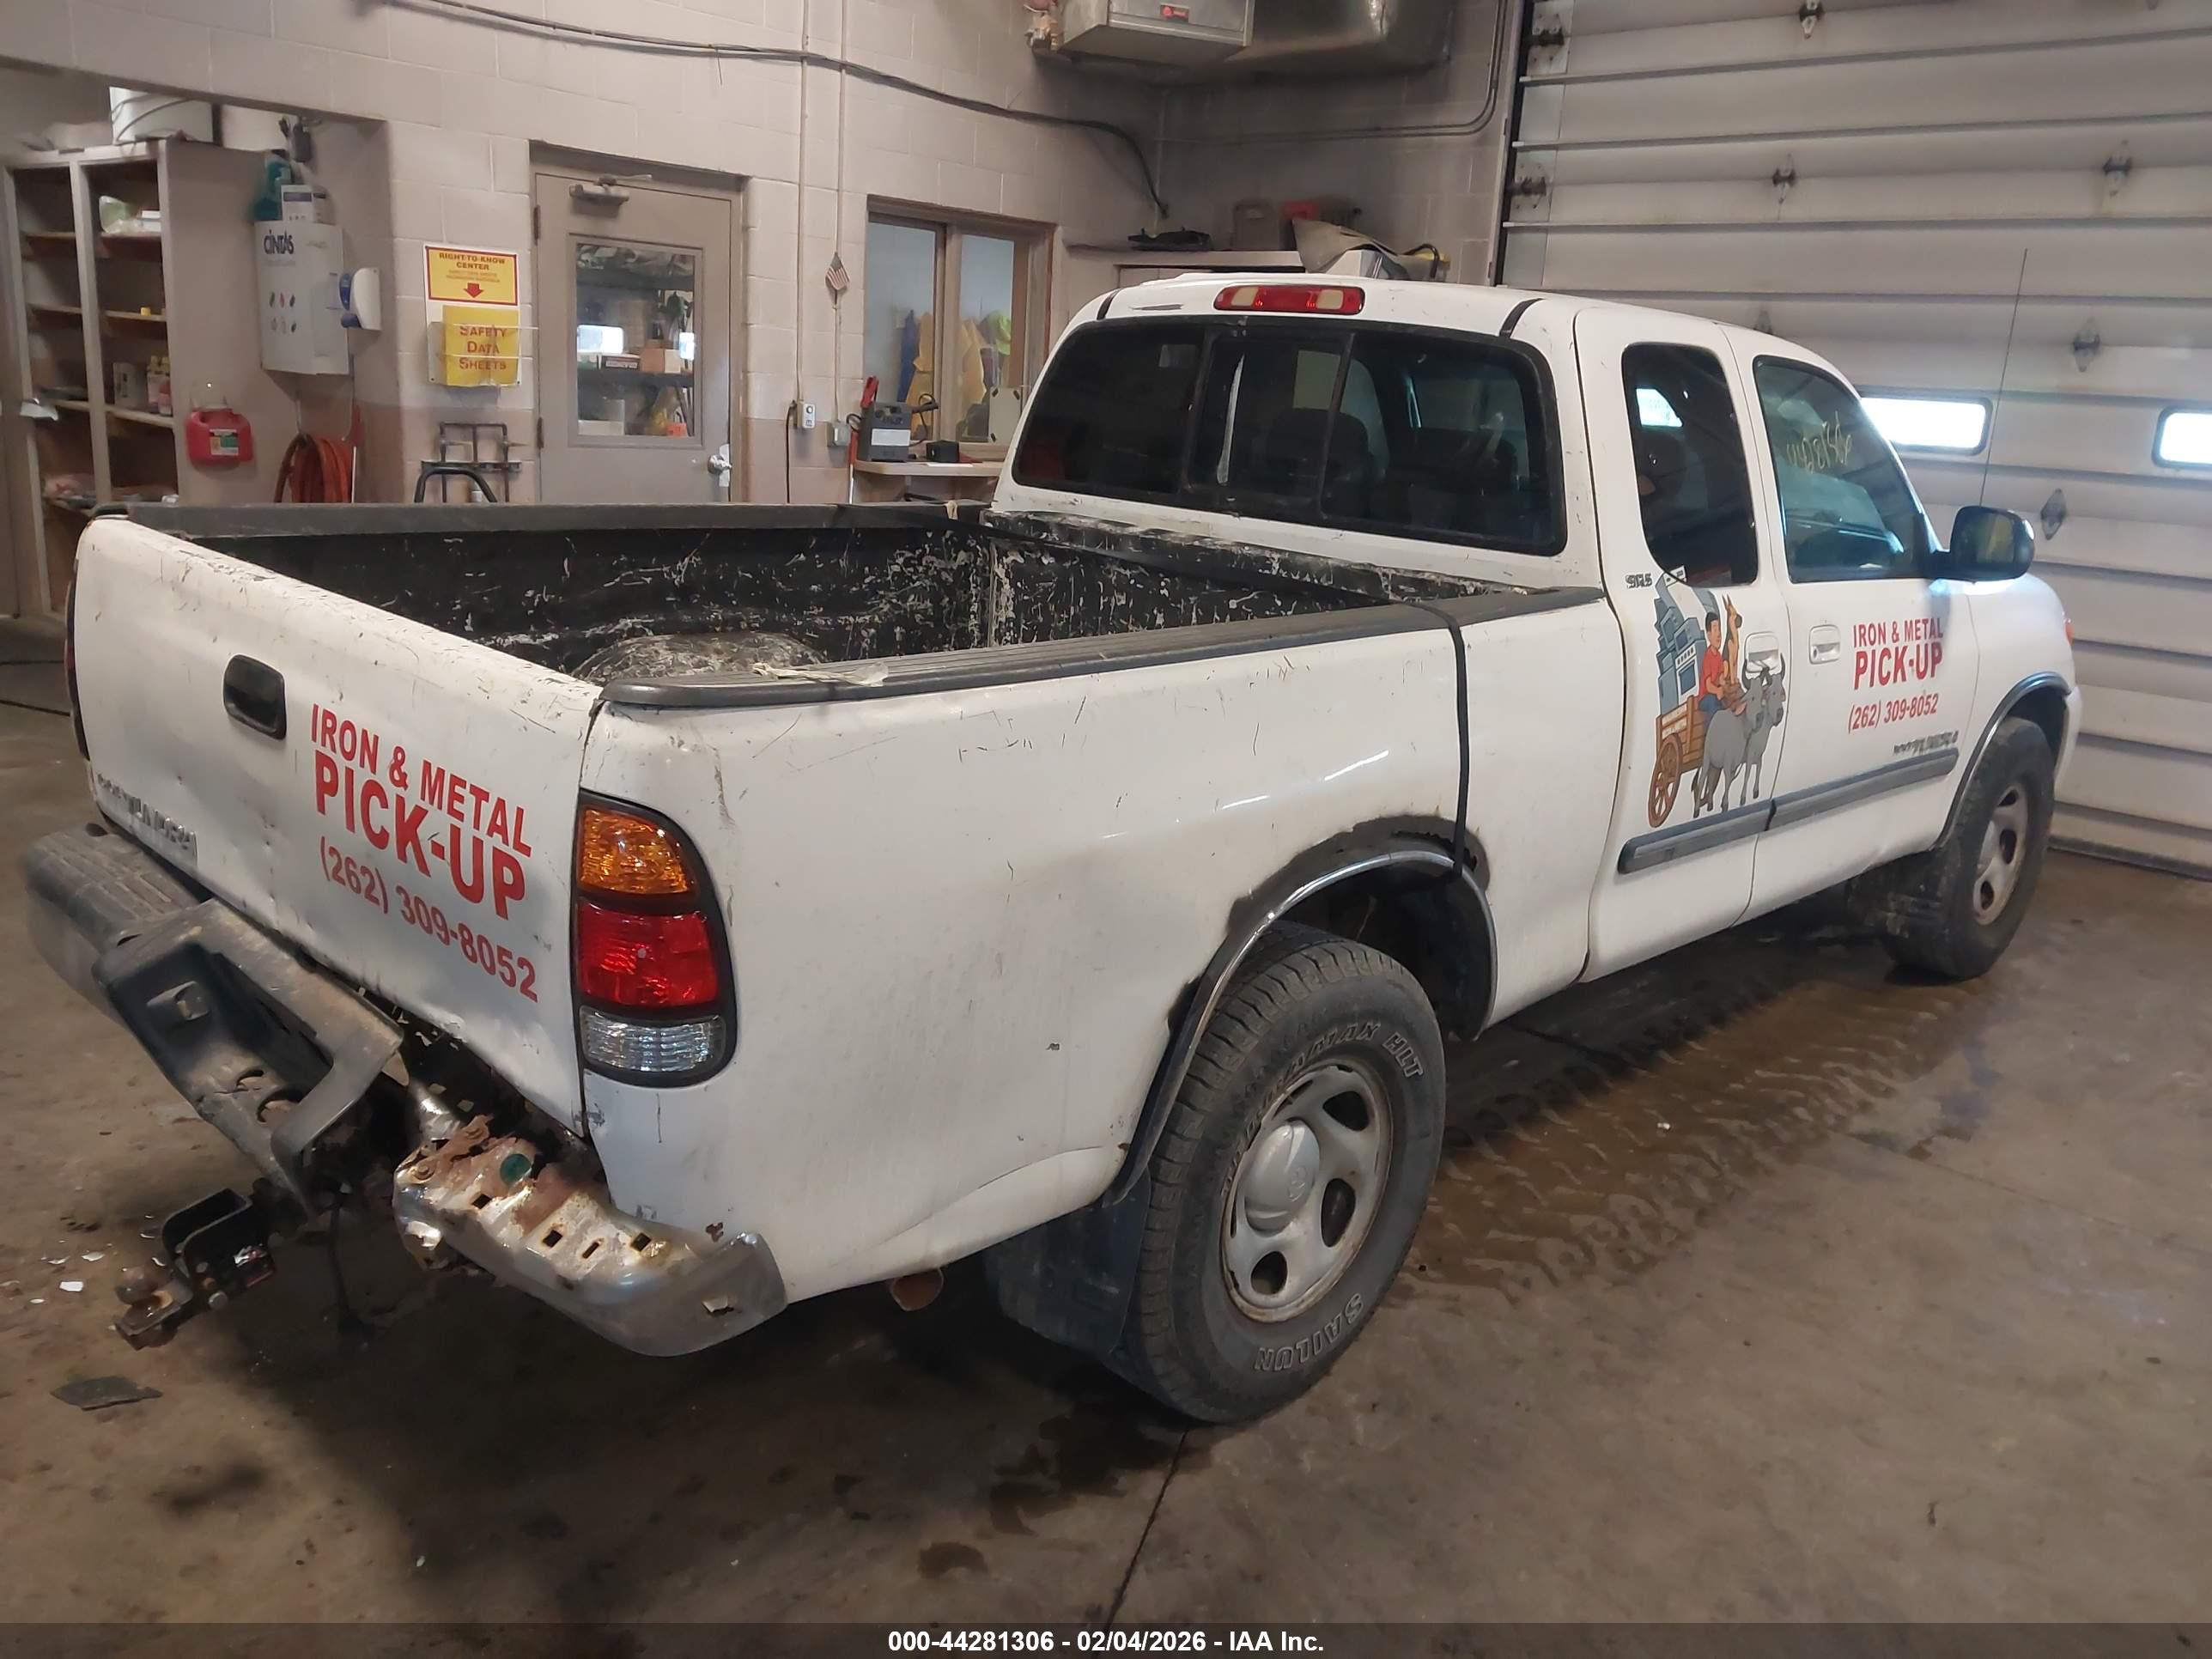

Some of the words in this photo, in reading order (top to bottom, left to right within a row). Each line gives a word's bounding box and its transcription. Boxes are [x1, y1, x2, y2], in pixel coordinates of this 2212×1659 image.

[456, 261, 489, 270] CENTER
[459, 325, 507, 337] SAFETY
[466, 341, 500, 355] DATA
[459, 357, 507, 370] SHEETS
[1853, 622, 1887, 647] IRON
[1892, 621, 1900, 643] &
[1904, 617, 1944, 642] METAL
[1854, 641, 1943, 690] PICK-UP
[1848, 701, 1881, 734] (262)
[1883, 693, 1940, 723] 309-8052
[311, 703, 380, 775] IRON
[389, 745, 410, 791] &
[420, 759, 532, 858] METAL
[314, 749, 526, 921] PICK-UP
[320, 836, 389, 915] (262)
[396, 885, 538, 1003] 309-8052
[1382, 1031, 1424, 1078] HLT
[1255, 1292, 1364, 1371] SAILUN
